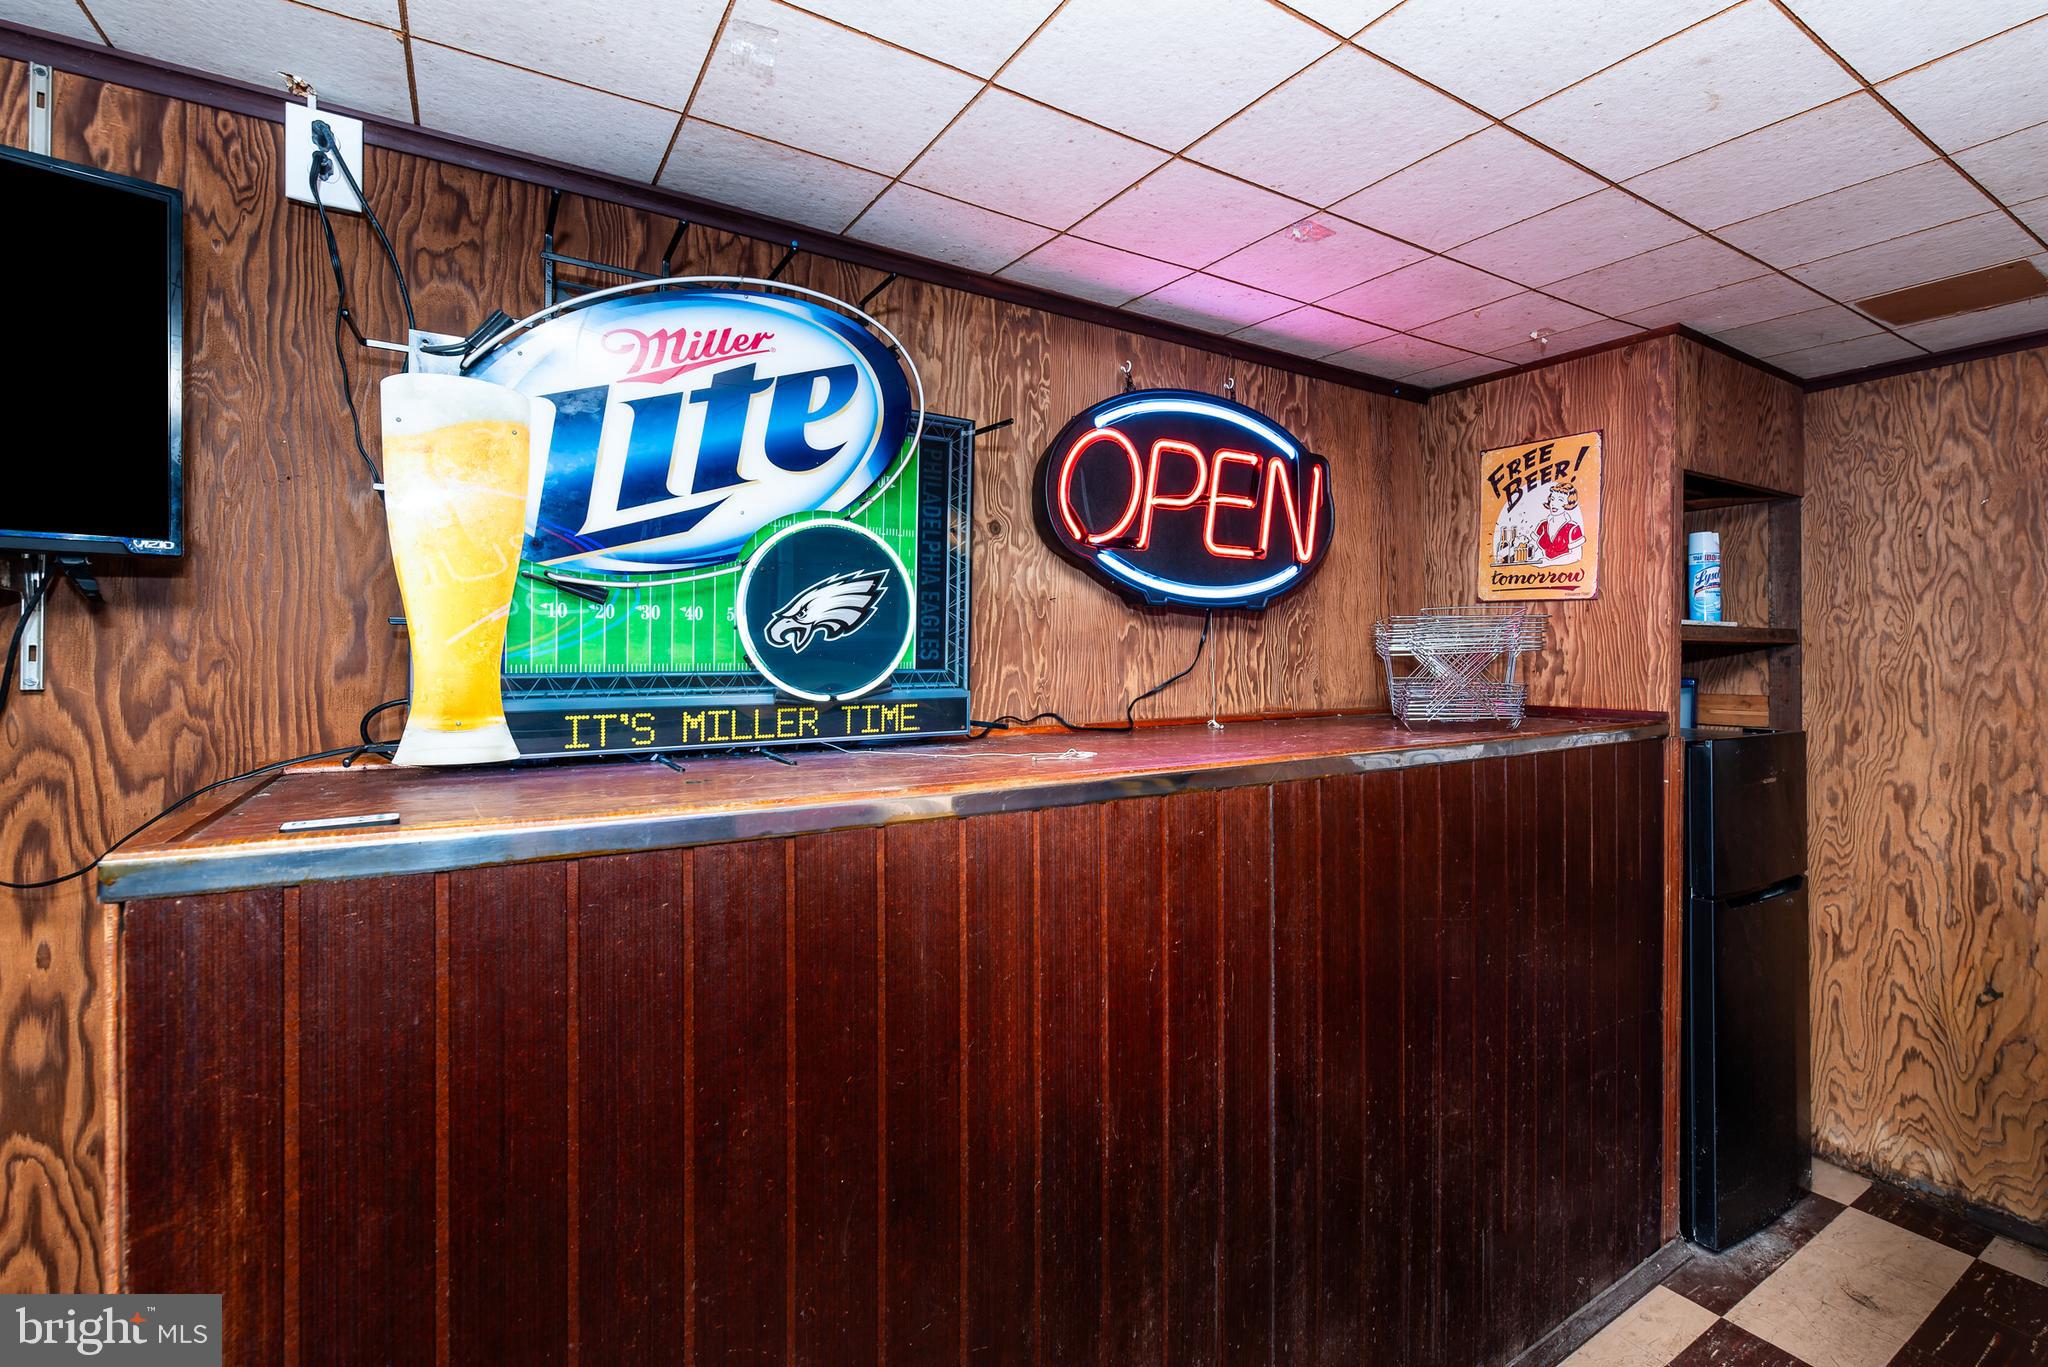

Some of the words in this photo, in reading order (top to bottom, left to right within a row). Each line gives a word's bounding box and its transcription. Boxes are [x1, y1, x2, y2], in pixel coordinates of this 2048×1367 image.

[602, 327, 775, 375] Miller
[530, 361, 859, 563] Lite
[1487, 442, 1555, 499] FREE
[1502, 445, 1590, 514] BEER!
[922, 448, 945, 586] PHILADELPHIA
[1057, 427, 1323, 564] OPEN
[132, 538, 175, 550] VIZIO
[1491, 567, 1585, 586] tomorrow
[548, 602, 568, 618] 10
[595, 603, 615, 619] 20
[641, 604, 661, 620] 30
[684, 605, 703, 621] 40
[726, 606, 738, 622] 5
[921, 590, 941, 661] EAGLES
[564, 711, 656, 750] IT'S
[682, 706, 819, 744] MILLER
[841, 703, 921, 735] TIME
